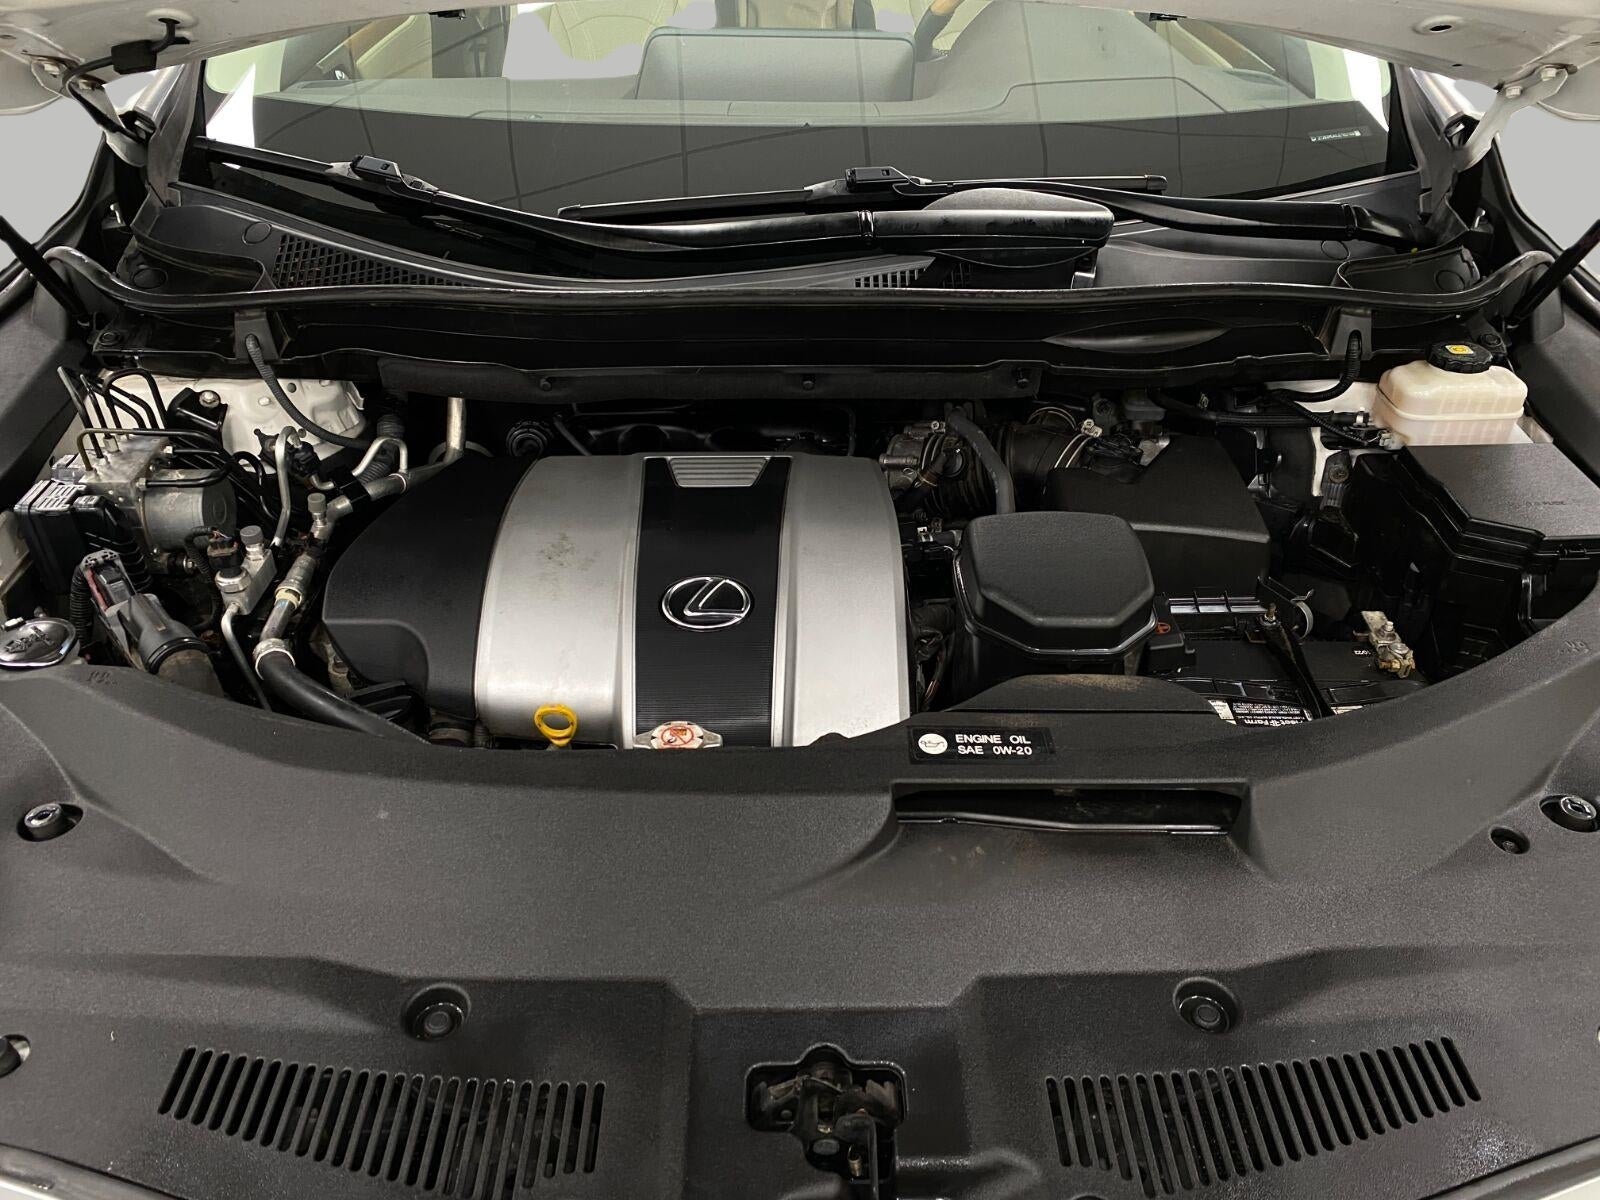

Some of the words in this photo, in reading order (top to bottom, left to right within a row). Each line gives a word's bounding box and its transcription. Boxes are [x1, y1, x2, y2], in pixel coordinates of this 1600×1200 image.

[955, 734, 1002, 744] ENGINE
[1009, 735, 1032, 745] OIL
[957, 745, 984, 755] SAE
[992, 745, 1033, 756] 0W-20
